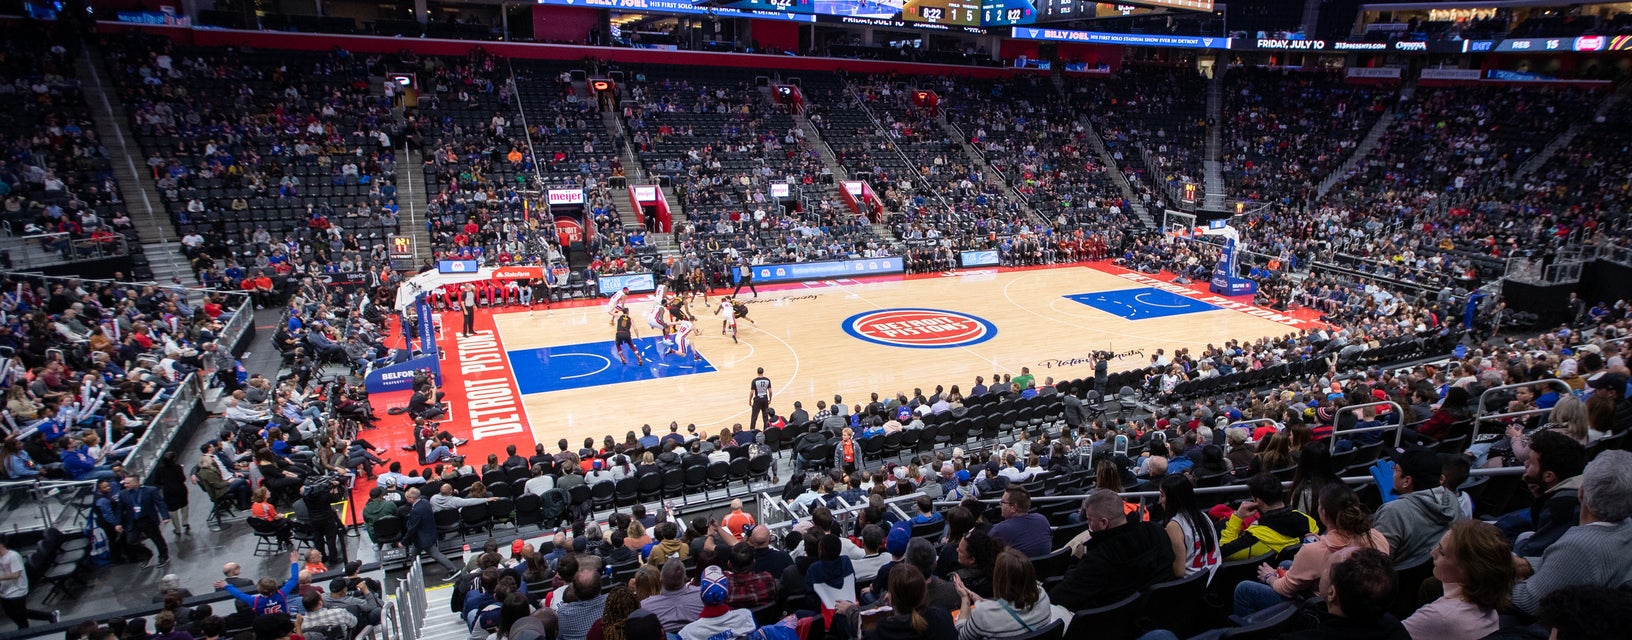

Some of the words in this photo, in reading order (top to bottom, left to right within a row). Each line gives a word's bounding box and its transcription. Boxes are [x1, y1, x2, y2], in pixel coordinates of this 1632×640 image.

[923, 7, 941, 19] 8:22
[951, 9, 956, 20] 1
[966, 10, 973, 22] 5
[985, 10, 991, 22] 6
[996, 9, 1002, 21] 2
[1044, 29, 1068, 39] BILLY
[1069, 31, 1089, 40] JOEL
[1257, 40, 1288, 49] FRIDAY,
[1290, 40, 1312, 49] JULY
[1313, 40, 1325, 49] 10
[1511, 41, 1531, 49] REB
[1546, 39, 1559, 49] 15
[550, 190, 581, 202] meijer
[1117, 272, 1203, 296] DETROIT
[1199, 295, 1307, 325] PISTONS
[870, 316, 955, 332] DETROIT
[879, 322, 969, 338] PISTONS
[456, 329, 504, 375] PISTONS
[381, 370, 414, 381] BELFOR
[464, 377, 523, 441] DETROIT
